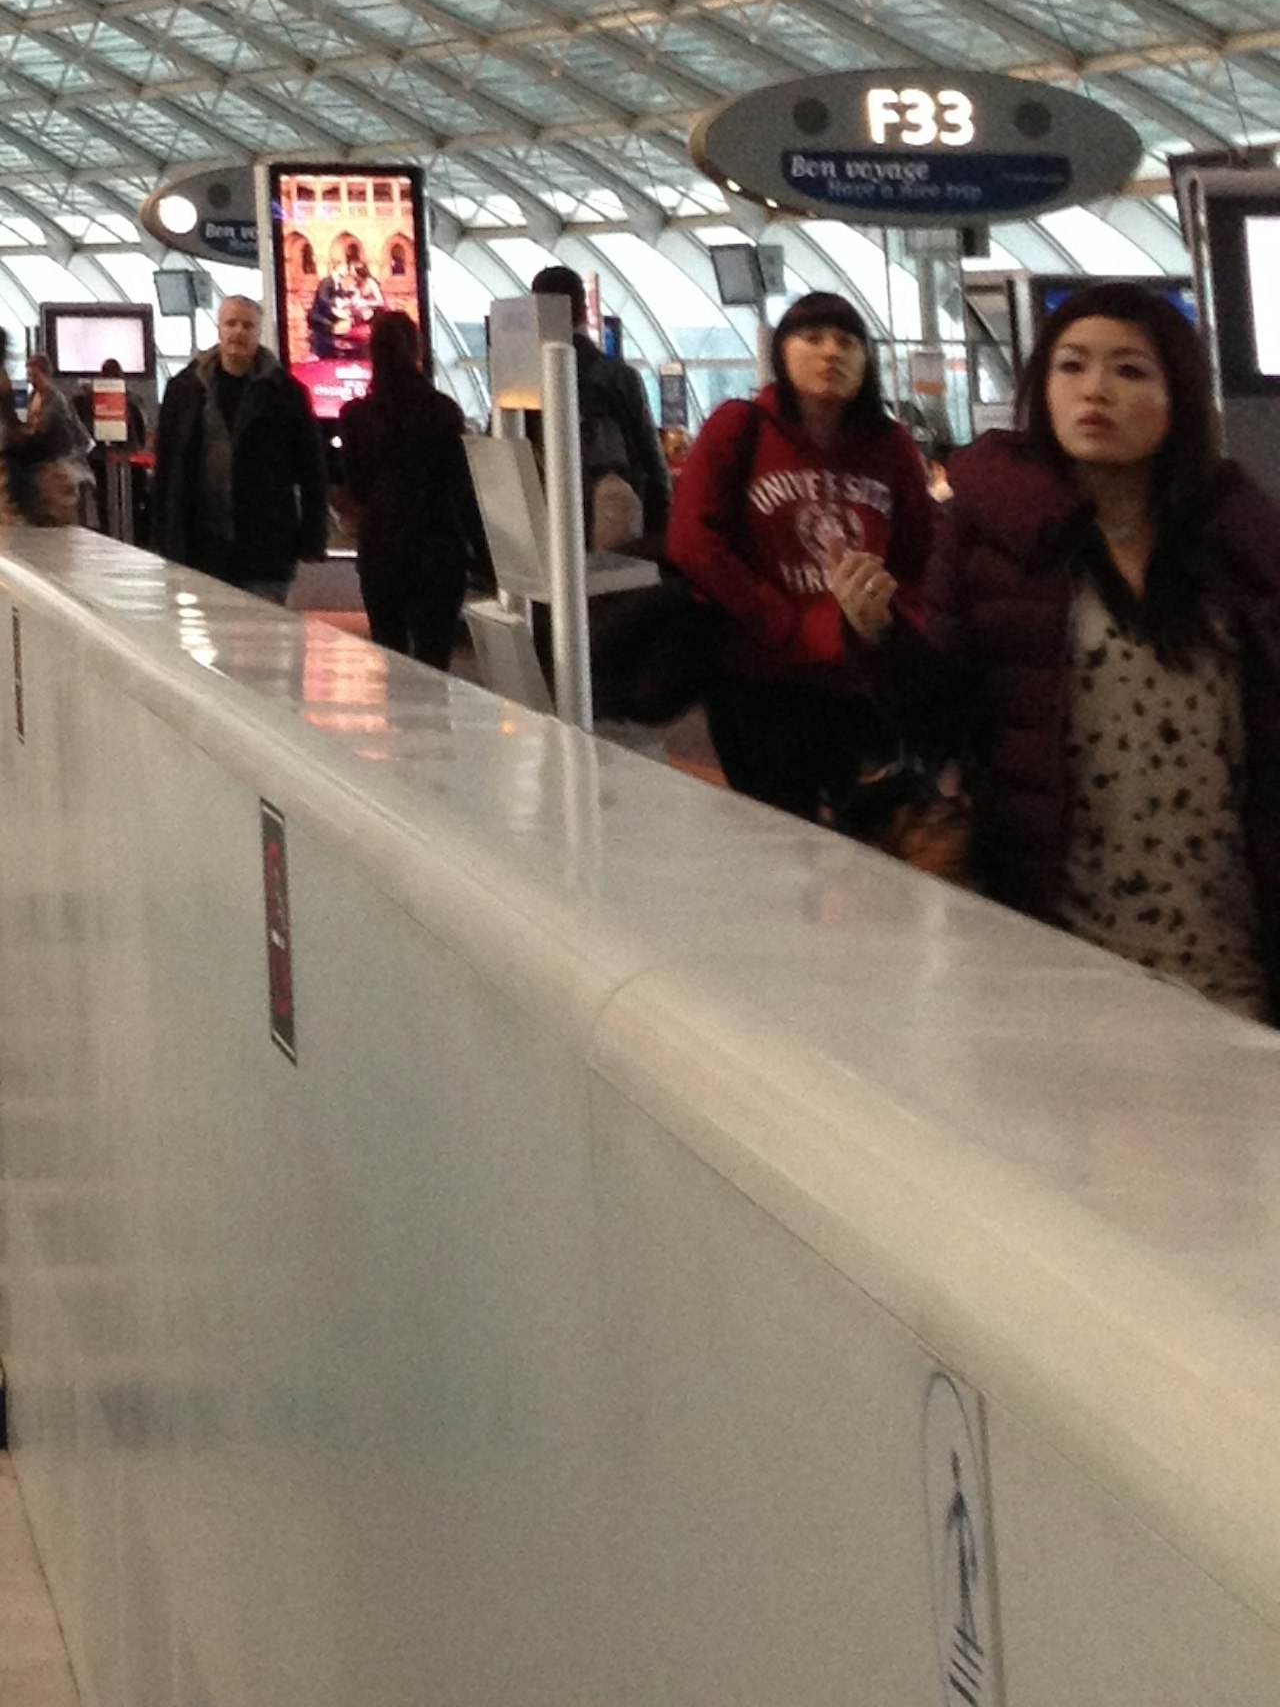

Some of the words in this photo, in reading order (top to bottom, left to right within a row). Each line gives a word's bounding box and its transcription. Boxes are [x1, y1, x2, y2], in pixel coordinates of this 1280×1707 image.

[865, 87, 975, 147] F33
[791, 154, 836, 178] Bon
[845, 160, 930, 187] voyage
